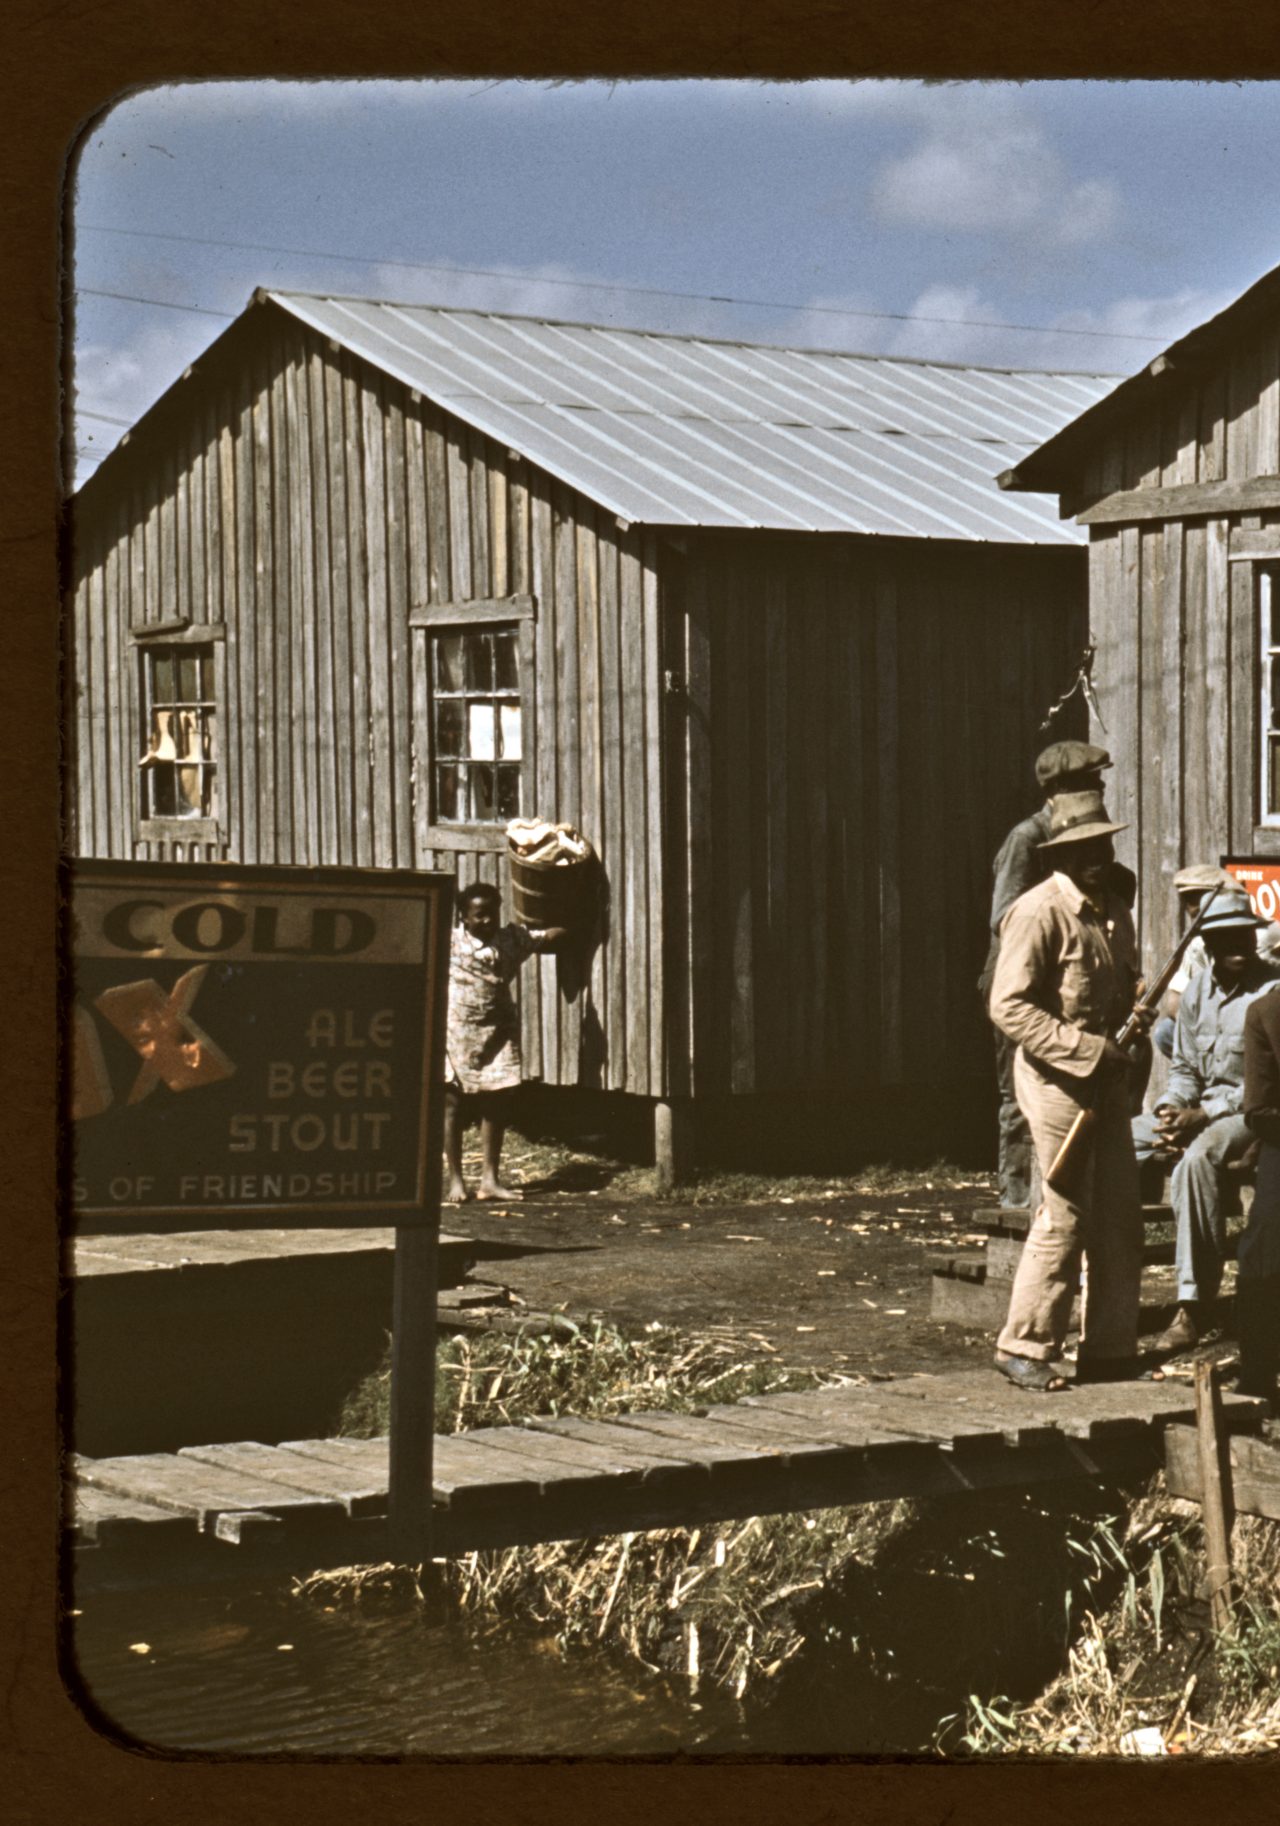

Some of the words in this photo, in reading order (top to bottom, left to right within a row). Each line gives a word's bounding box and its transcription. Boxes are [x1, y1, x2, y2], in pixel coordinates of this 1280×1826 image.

[1235, 870, 1263, 881] DRINK
[103, 899, 377, 956] COLD
[306, 1009, 395, 1047] ALE
[267, 1061, 392, 1099] BEER
[229, 1112, 391, 1152] STOUT
[109, 1175, 156, 1200] OF
[180, 1171, 398, 1200] FRIENDSHIP
